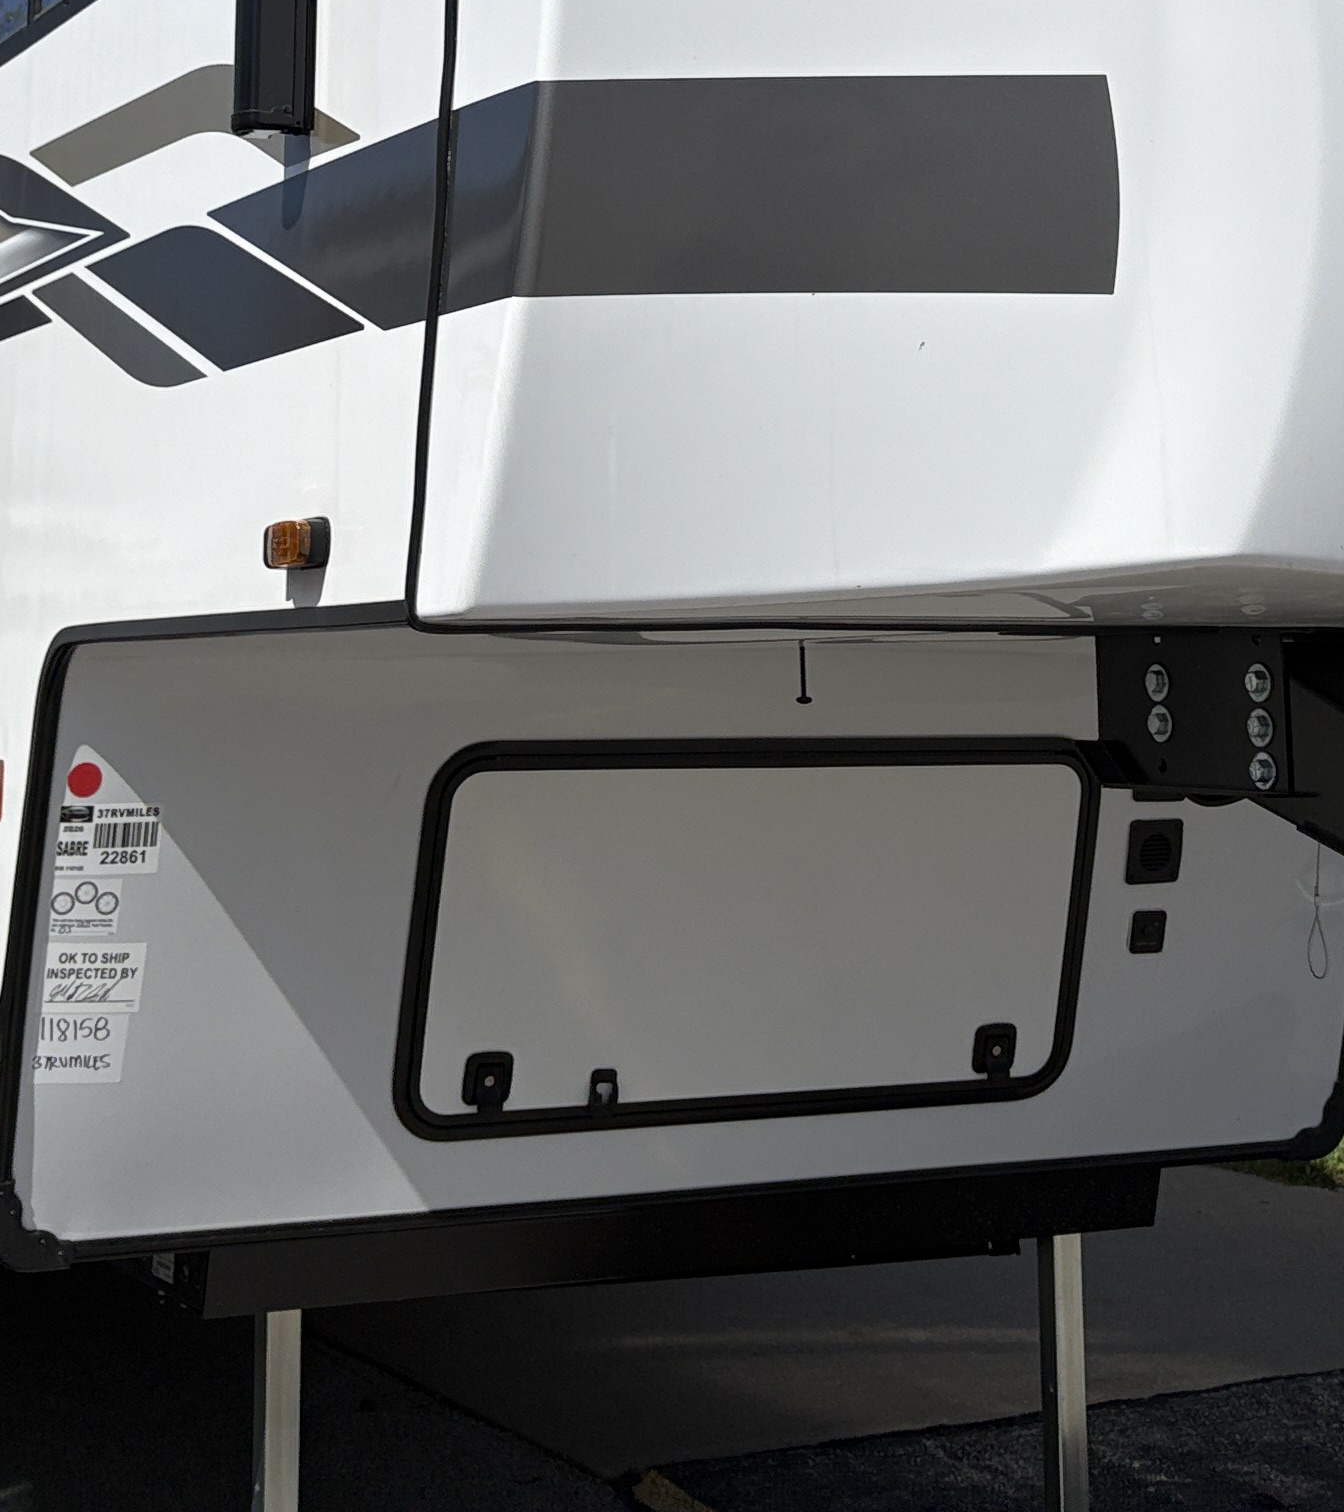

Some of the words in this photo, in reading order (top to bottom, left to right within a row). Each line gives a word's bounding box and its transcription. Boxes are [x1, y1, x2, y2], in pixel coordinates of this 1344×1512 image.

[97, 807, 160, 819] 37RVMILES
[56, 840, 90, 857] SABRE
[99, 850, 147, 865] 22861
[58, 952, 78, 964] OK
[81, 952, 98, 964] TO
[100, 952, 130, 964] SHIP
[46, 967, 118, 979] INSPECTED
[120, 967, 138, 979] BY
